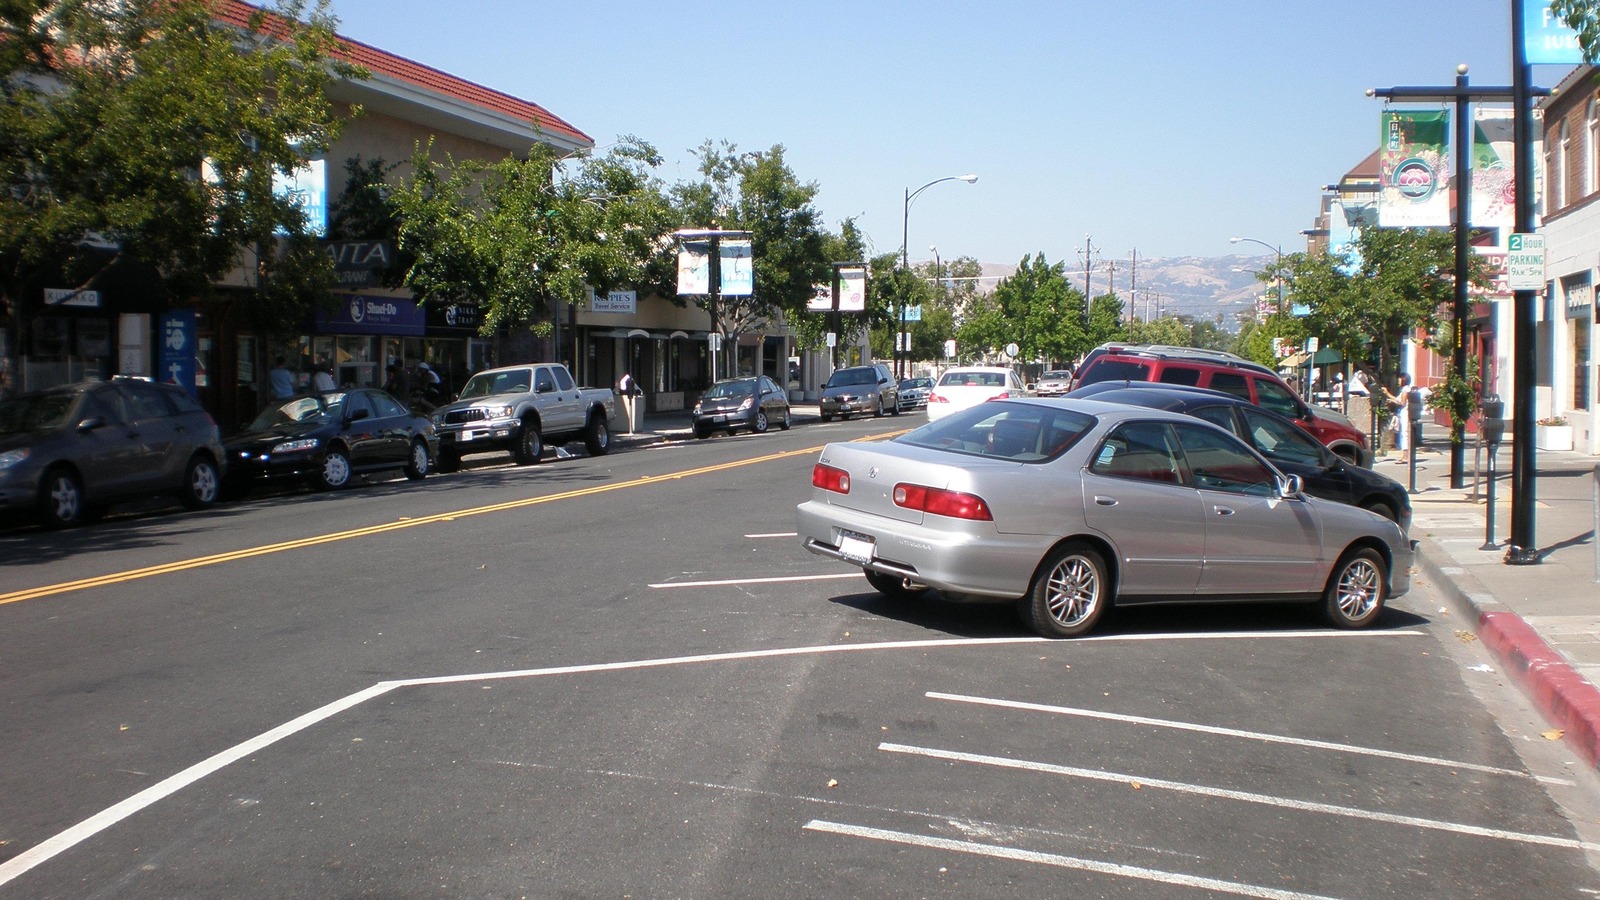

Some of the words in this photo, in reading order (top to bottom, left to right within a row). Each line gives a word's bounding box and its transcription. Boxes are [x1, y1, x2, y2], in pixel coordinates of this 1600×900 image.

[1545, 34, 1579, 49] JUL
[1390, 122, 1399, 149] 日本町
[1511, 236, 1521, 249] 2
[1523, 239, 1543, 249] HOUR
[1510, 255, 1543, 265] PARKING
[594, 293, 631, 301] PIE'S
[367, 302, 396, 315] Shuei-Do
